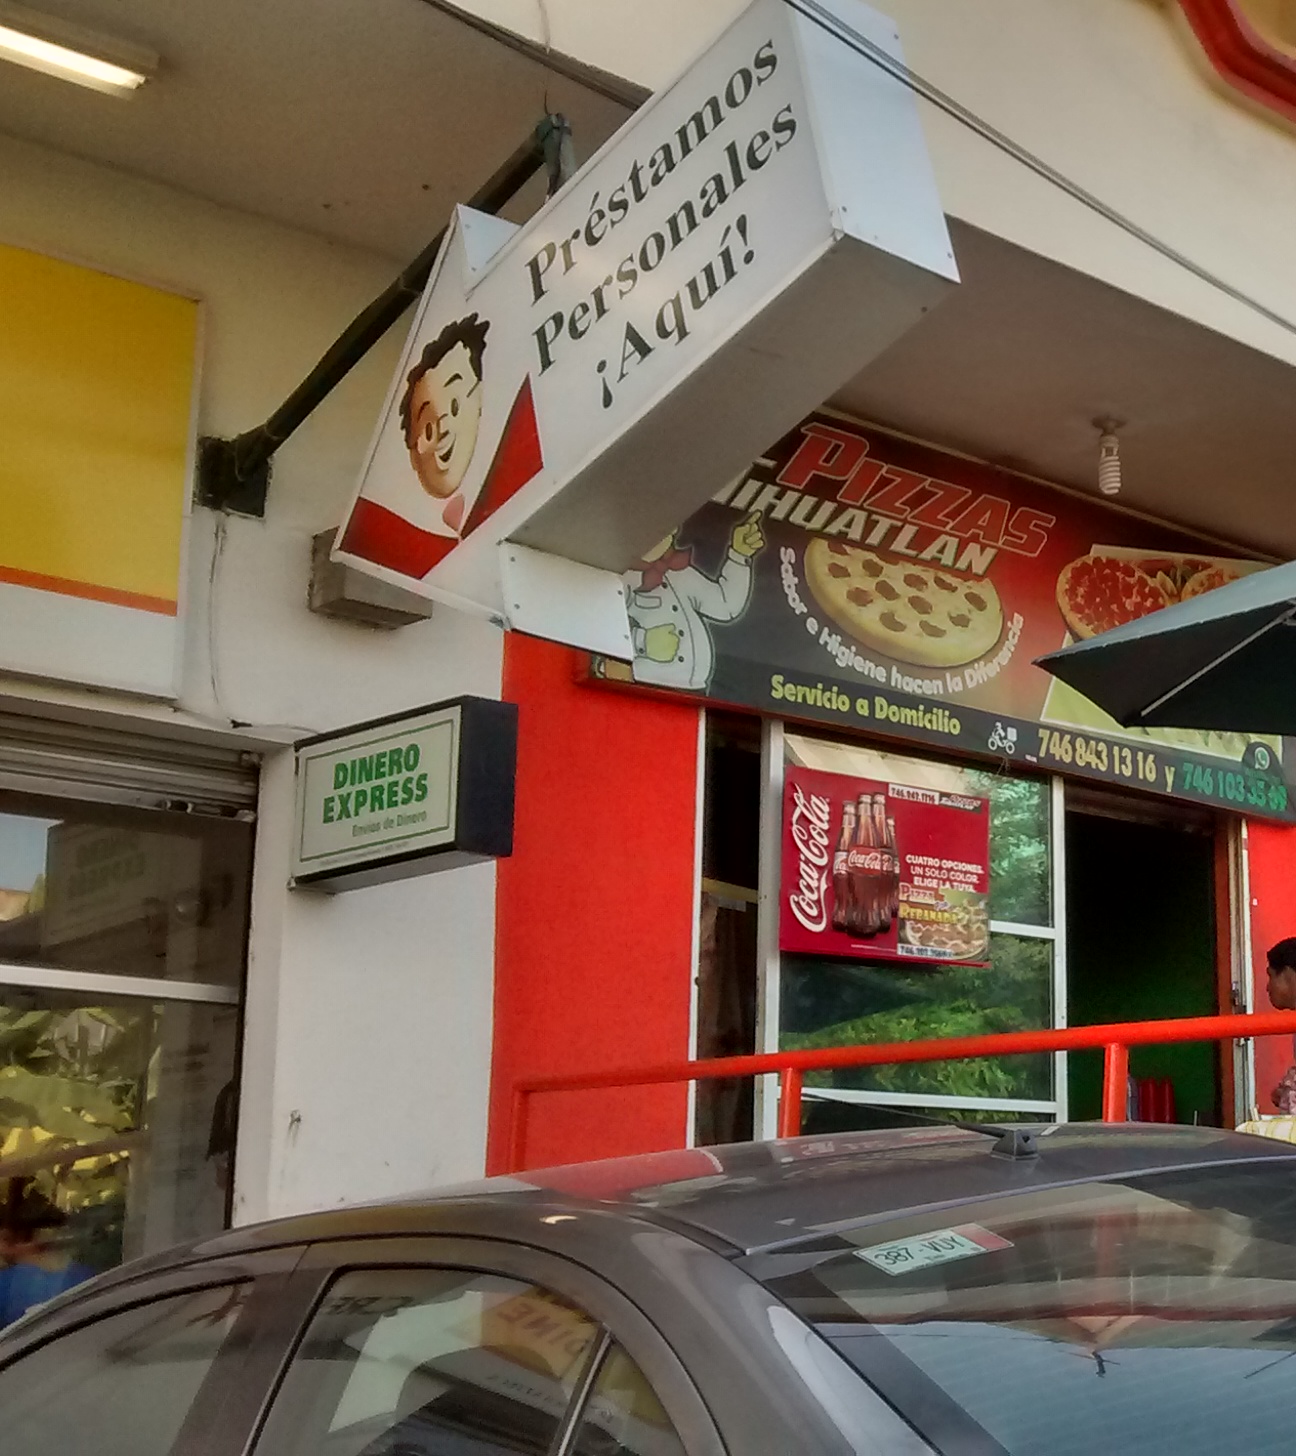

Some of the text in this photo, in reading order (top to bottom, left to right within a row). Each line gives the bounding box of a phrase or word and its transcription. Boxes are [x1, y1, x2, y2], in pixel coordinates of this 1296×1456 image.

[524, 38, 778, 305] Préstamos
[532, 104, 798, 376] Personales
[595, 214, 755, 409] ¡Aquí!
[780, 547, 1024, 695] Sabor e Higiene hacen la Diferencia
[771, 674, 961, 735] Servicio a Domicilio
[332, 743, 421, 790] DINERO
[1038, 728, 1073, 764] 746
[1075, 738, 1108, 772] 843
[1113, 746, 1132, 777] 13
[1136, 751, 1157, 783] 16
[1183, 762, 1213, 795] 746
[322, 773, 429, 824] EXPRESS
[905, 854, 940, 867] CUATRO
[910, 866, 923, 875] UN
[925, 868, 948, 879] SOLO
[913, 876, 938, 888] ELIGE
